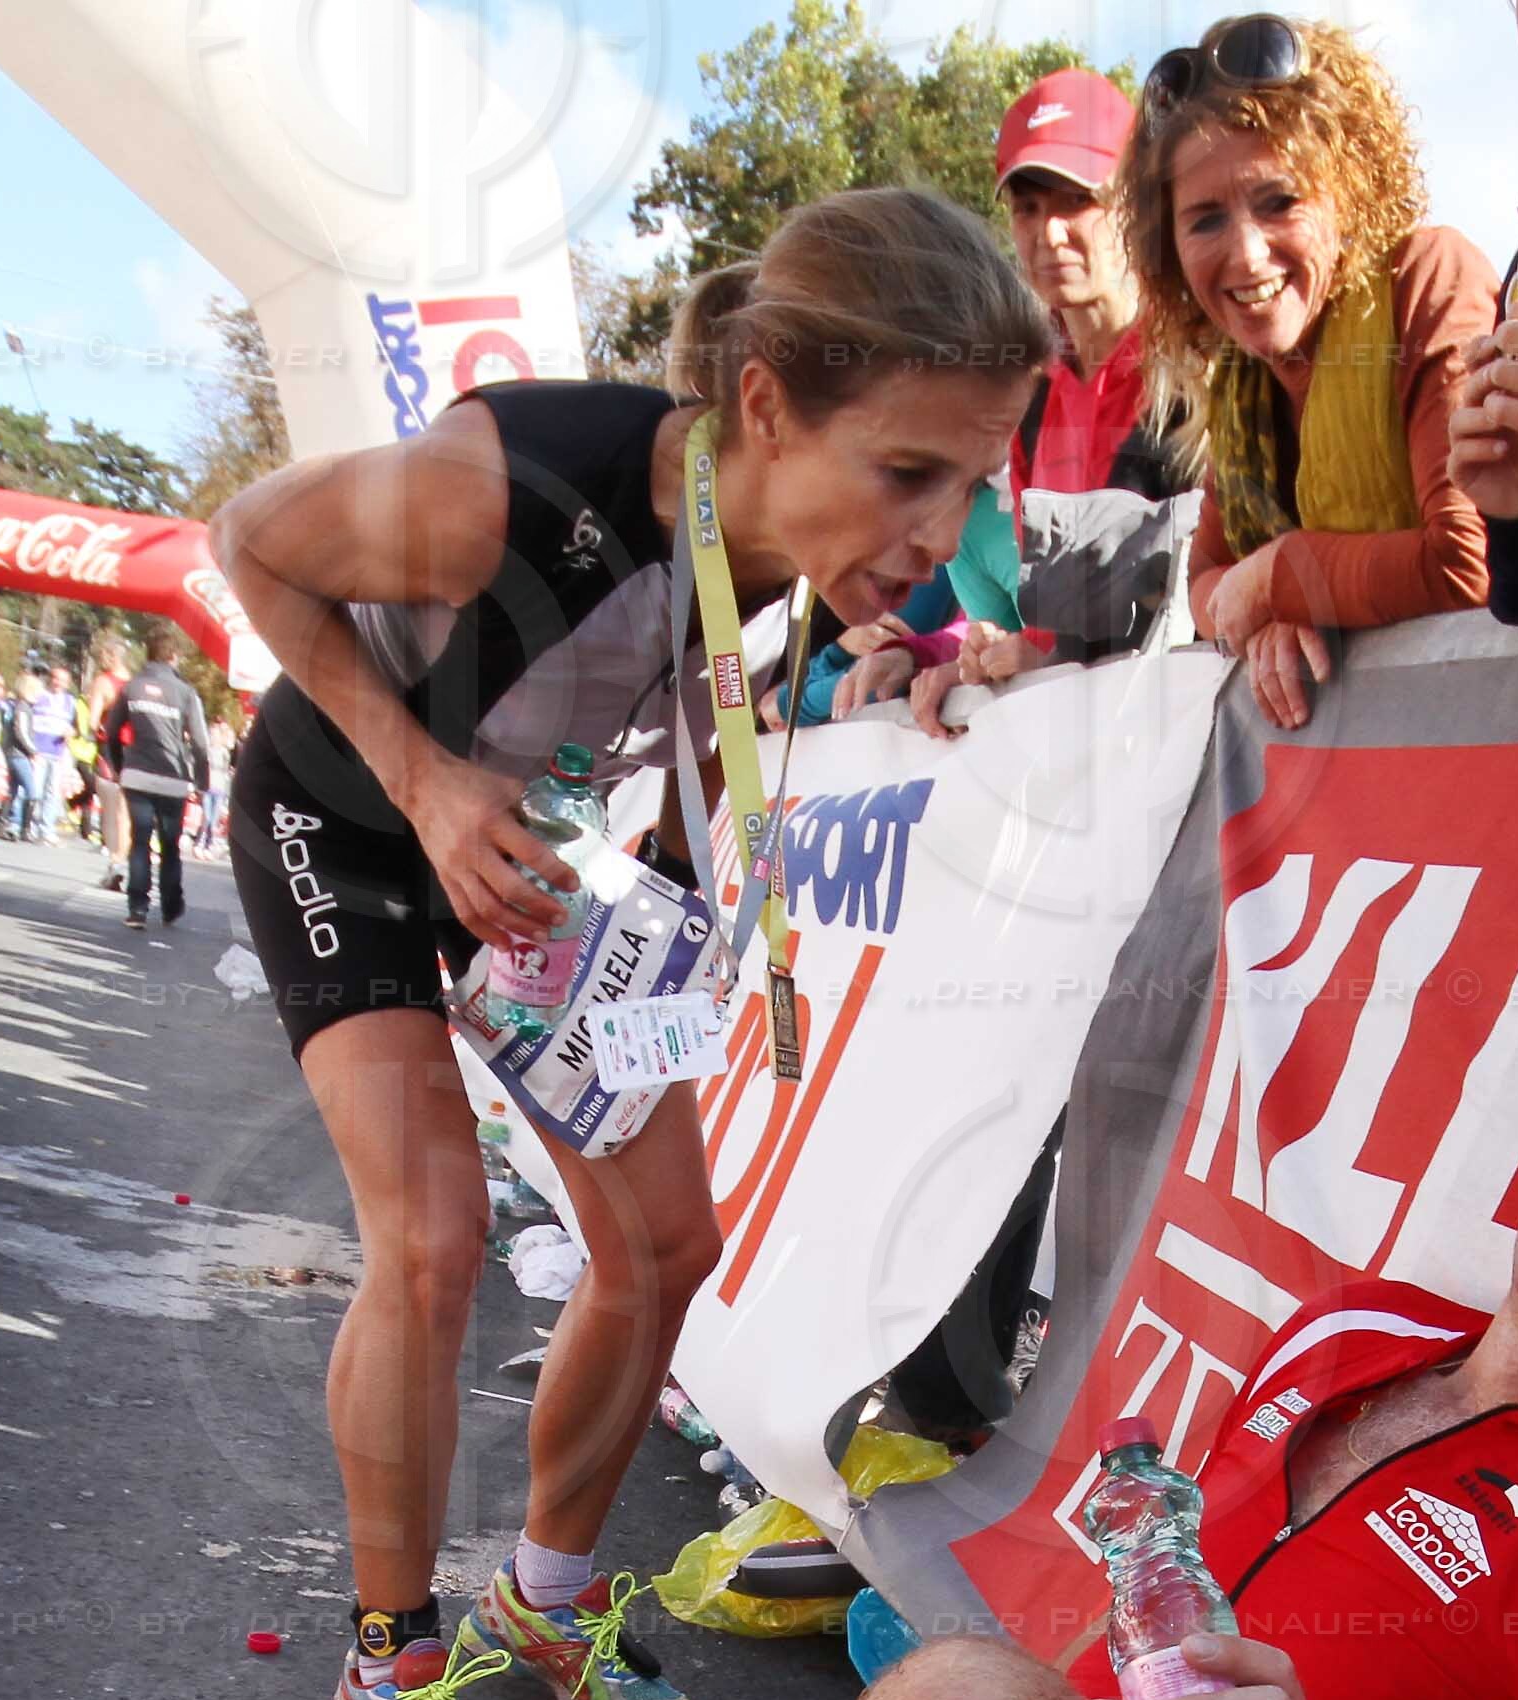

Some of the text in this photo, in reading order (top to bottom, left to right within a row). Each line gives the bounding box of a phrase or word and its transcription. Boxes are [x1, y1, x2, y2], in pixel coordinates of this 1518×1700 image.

[695, 454, 717, 545] GRAZ
[726, 655, 744, 706] KLEINE
[280, 838, 343, 960] odlo
[557, 927, 650, 1073] MICAELA
[1385, 1495, 1481, 1589] Leopold
